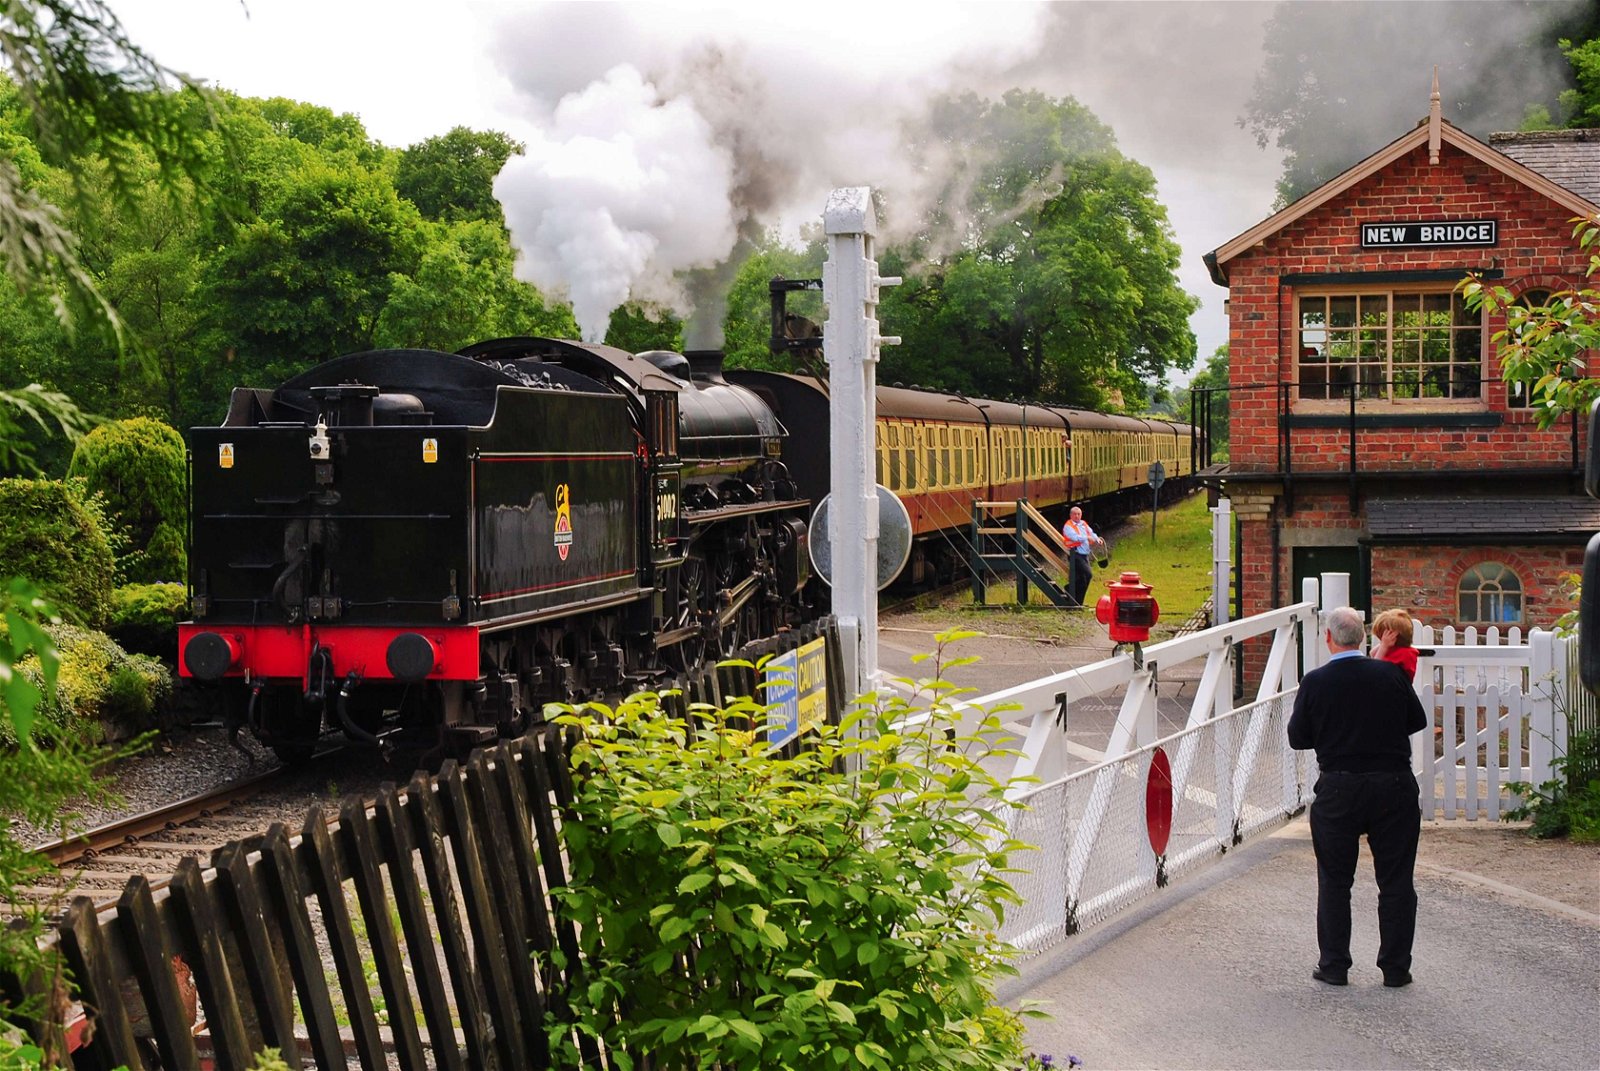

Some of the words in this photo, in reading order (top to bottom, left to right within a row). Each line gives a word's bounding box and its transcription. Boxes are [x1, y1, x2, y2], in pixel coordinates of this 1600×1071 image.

[1367, 227, 1406, 243] NEW
[1420, 225, 1490, 241] BRIDGE
[799, 652, 825, 693] CAUTION
